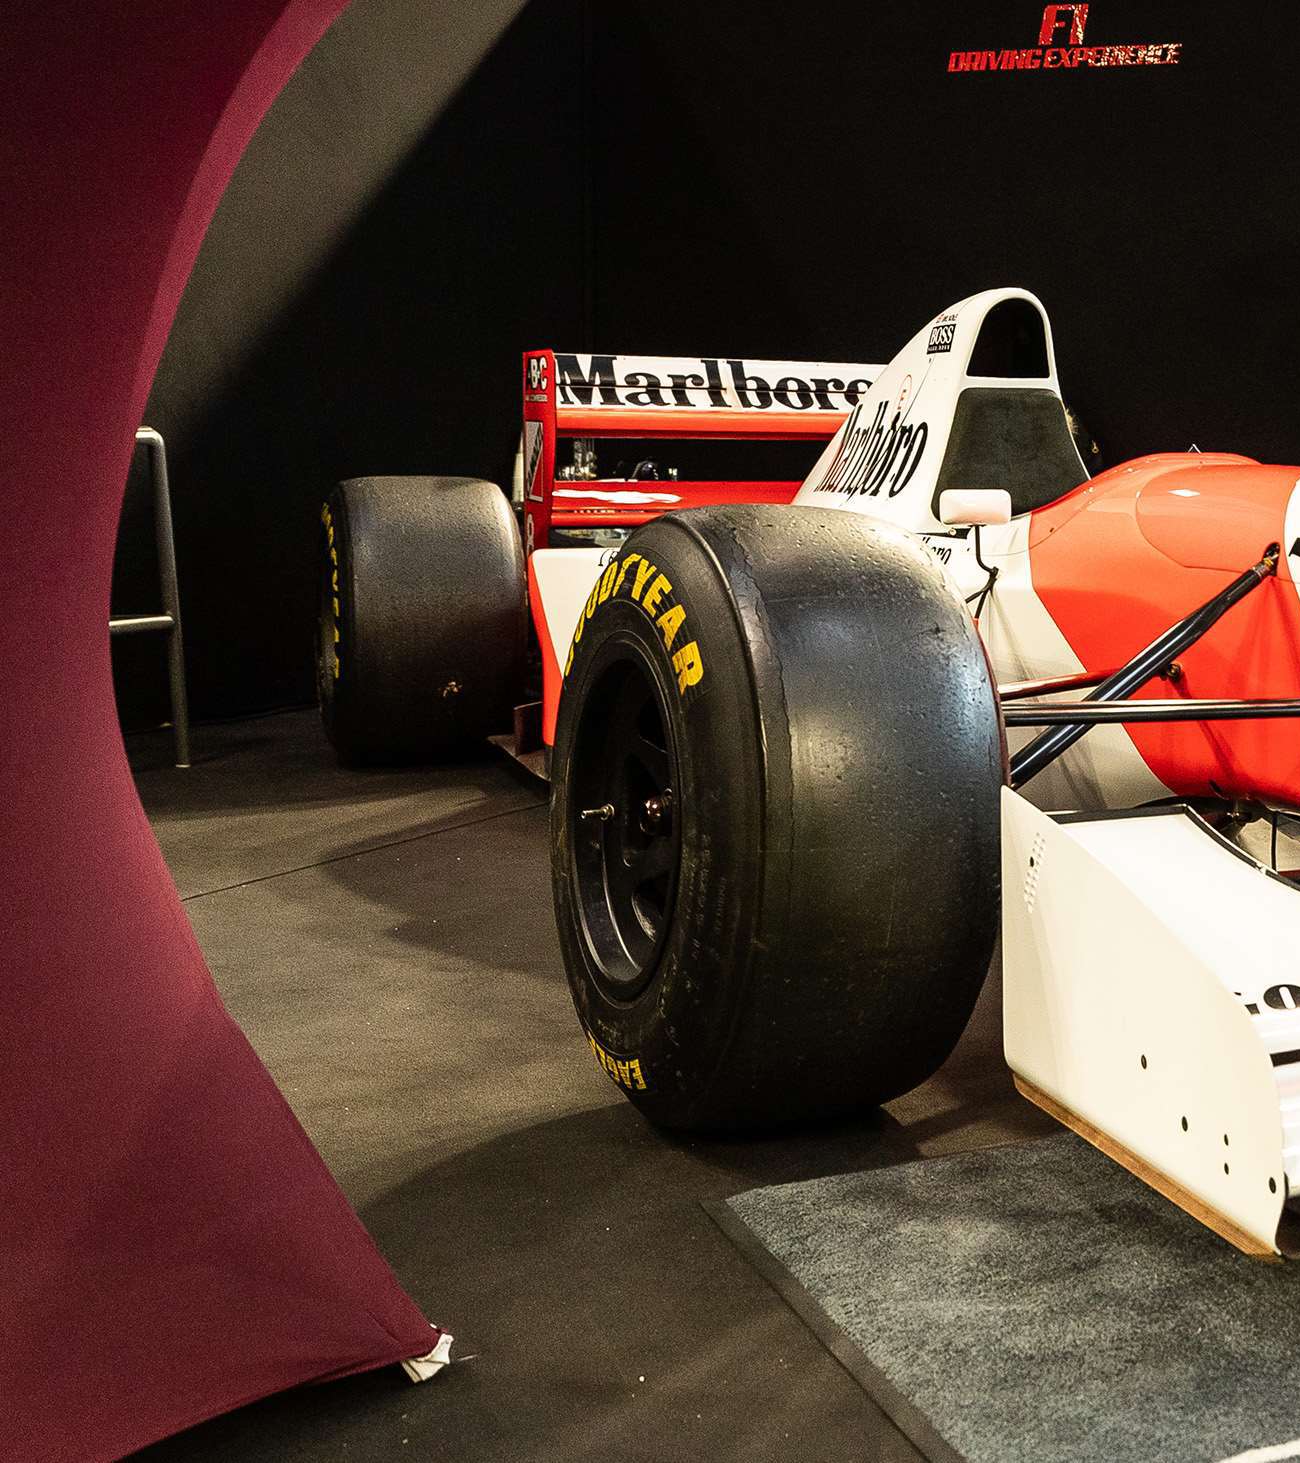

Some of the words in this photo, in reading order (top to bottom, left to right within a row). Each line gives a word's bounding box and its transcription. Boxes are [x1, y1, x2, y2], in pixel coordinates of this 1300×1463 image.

[1038, 3, 1089, 45] F1
[947, 48, 1043, 73] DRIVING
[1042, 43, 1184, 68] EXPERIENCE
[929, 324, 956, 346] BOSS
